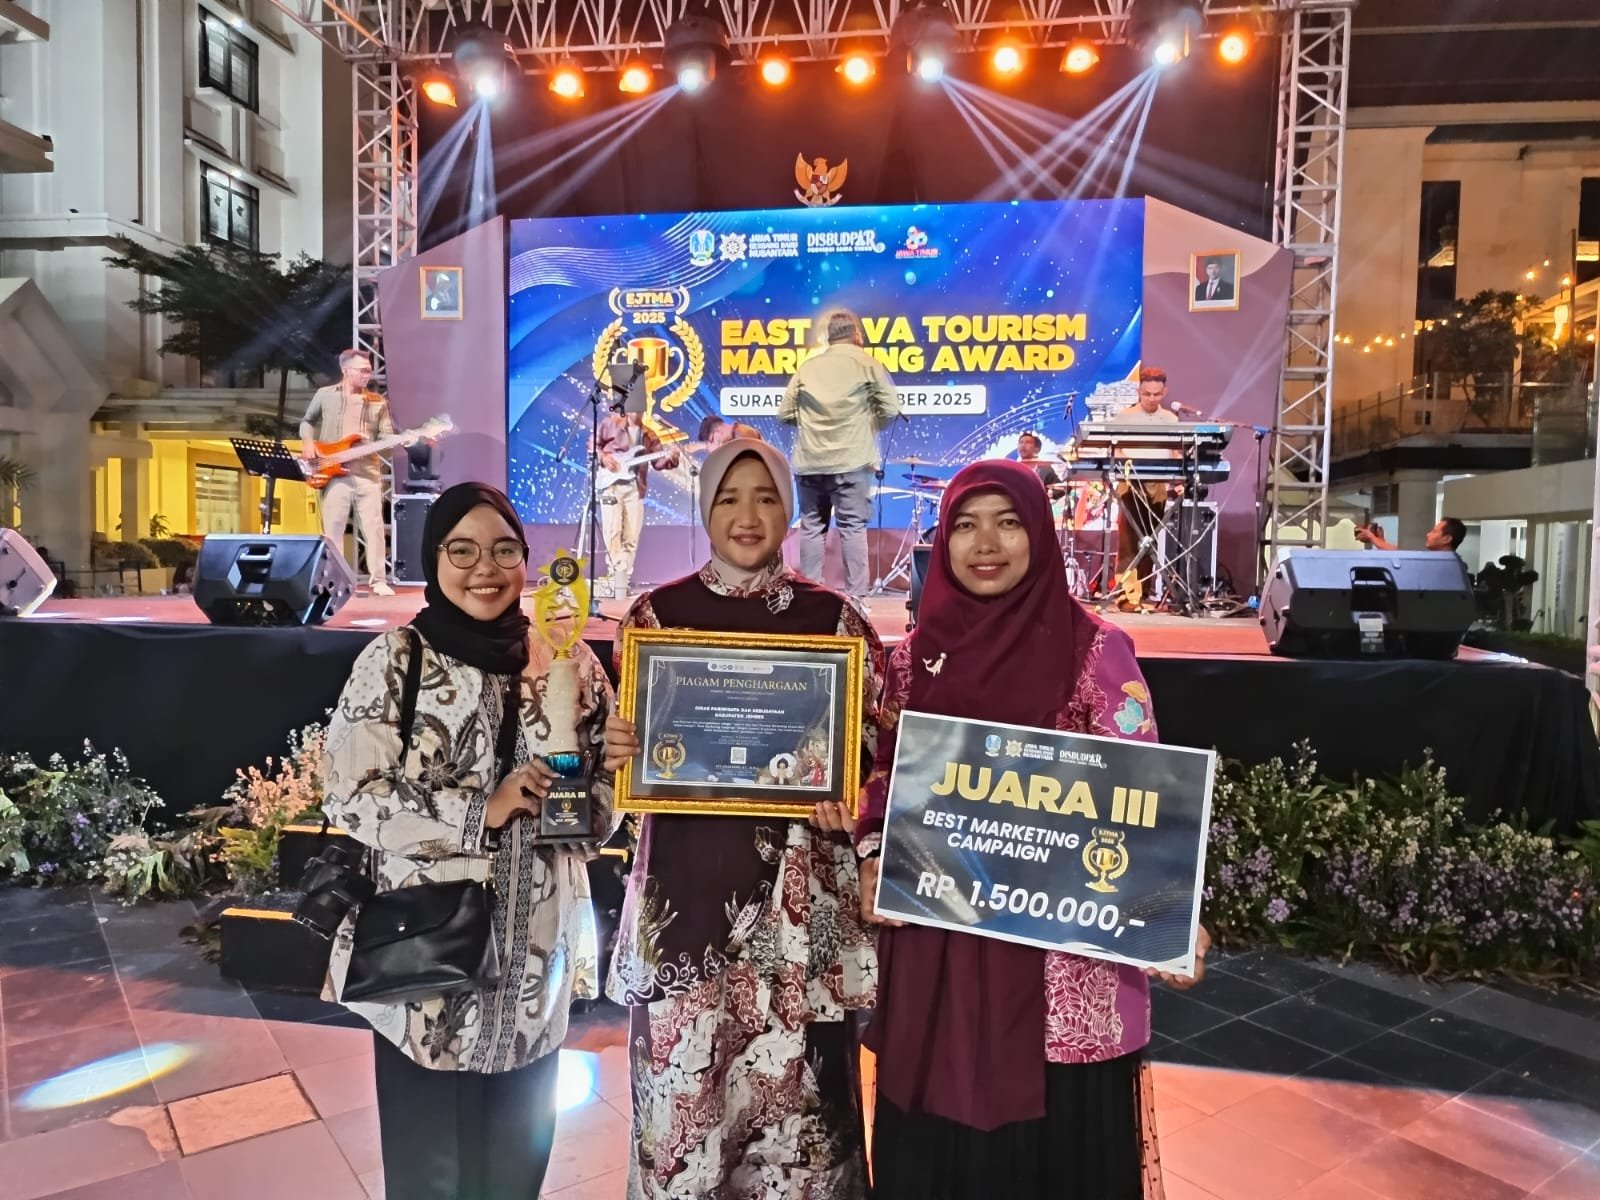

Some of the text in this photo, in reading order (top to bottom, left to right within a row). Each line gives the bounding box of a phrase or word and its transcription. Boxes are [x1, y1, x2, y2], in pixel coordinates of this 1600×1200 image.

[807, 229, 883, 251] DISBUDPAR
[749, 248, 798, 258] NUSANTARA
[626, 292, 674, 305] EJTMA
[633, 312, 666, 324] 2025
[721, 314, 1087, 346] EAST VA TOURISM
[931, 344, 1075, 372] AWARD
[934, 391, 972, 406] 2025
[676, 676, 808, 691] PIAGAM PENGHARGAAN
[548, 791, 586, 799] JUARA III
[930, 762, 1159, 828] JUARA III
[922, 809, 1080, 849] BEST MARKETING
[947, 832, 1050, 864] CAMPAIGN
[916, 871, 1146, 938] RP 1.500.000,-
